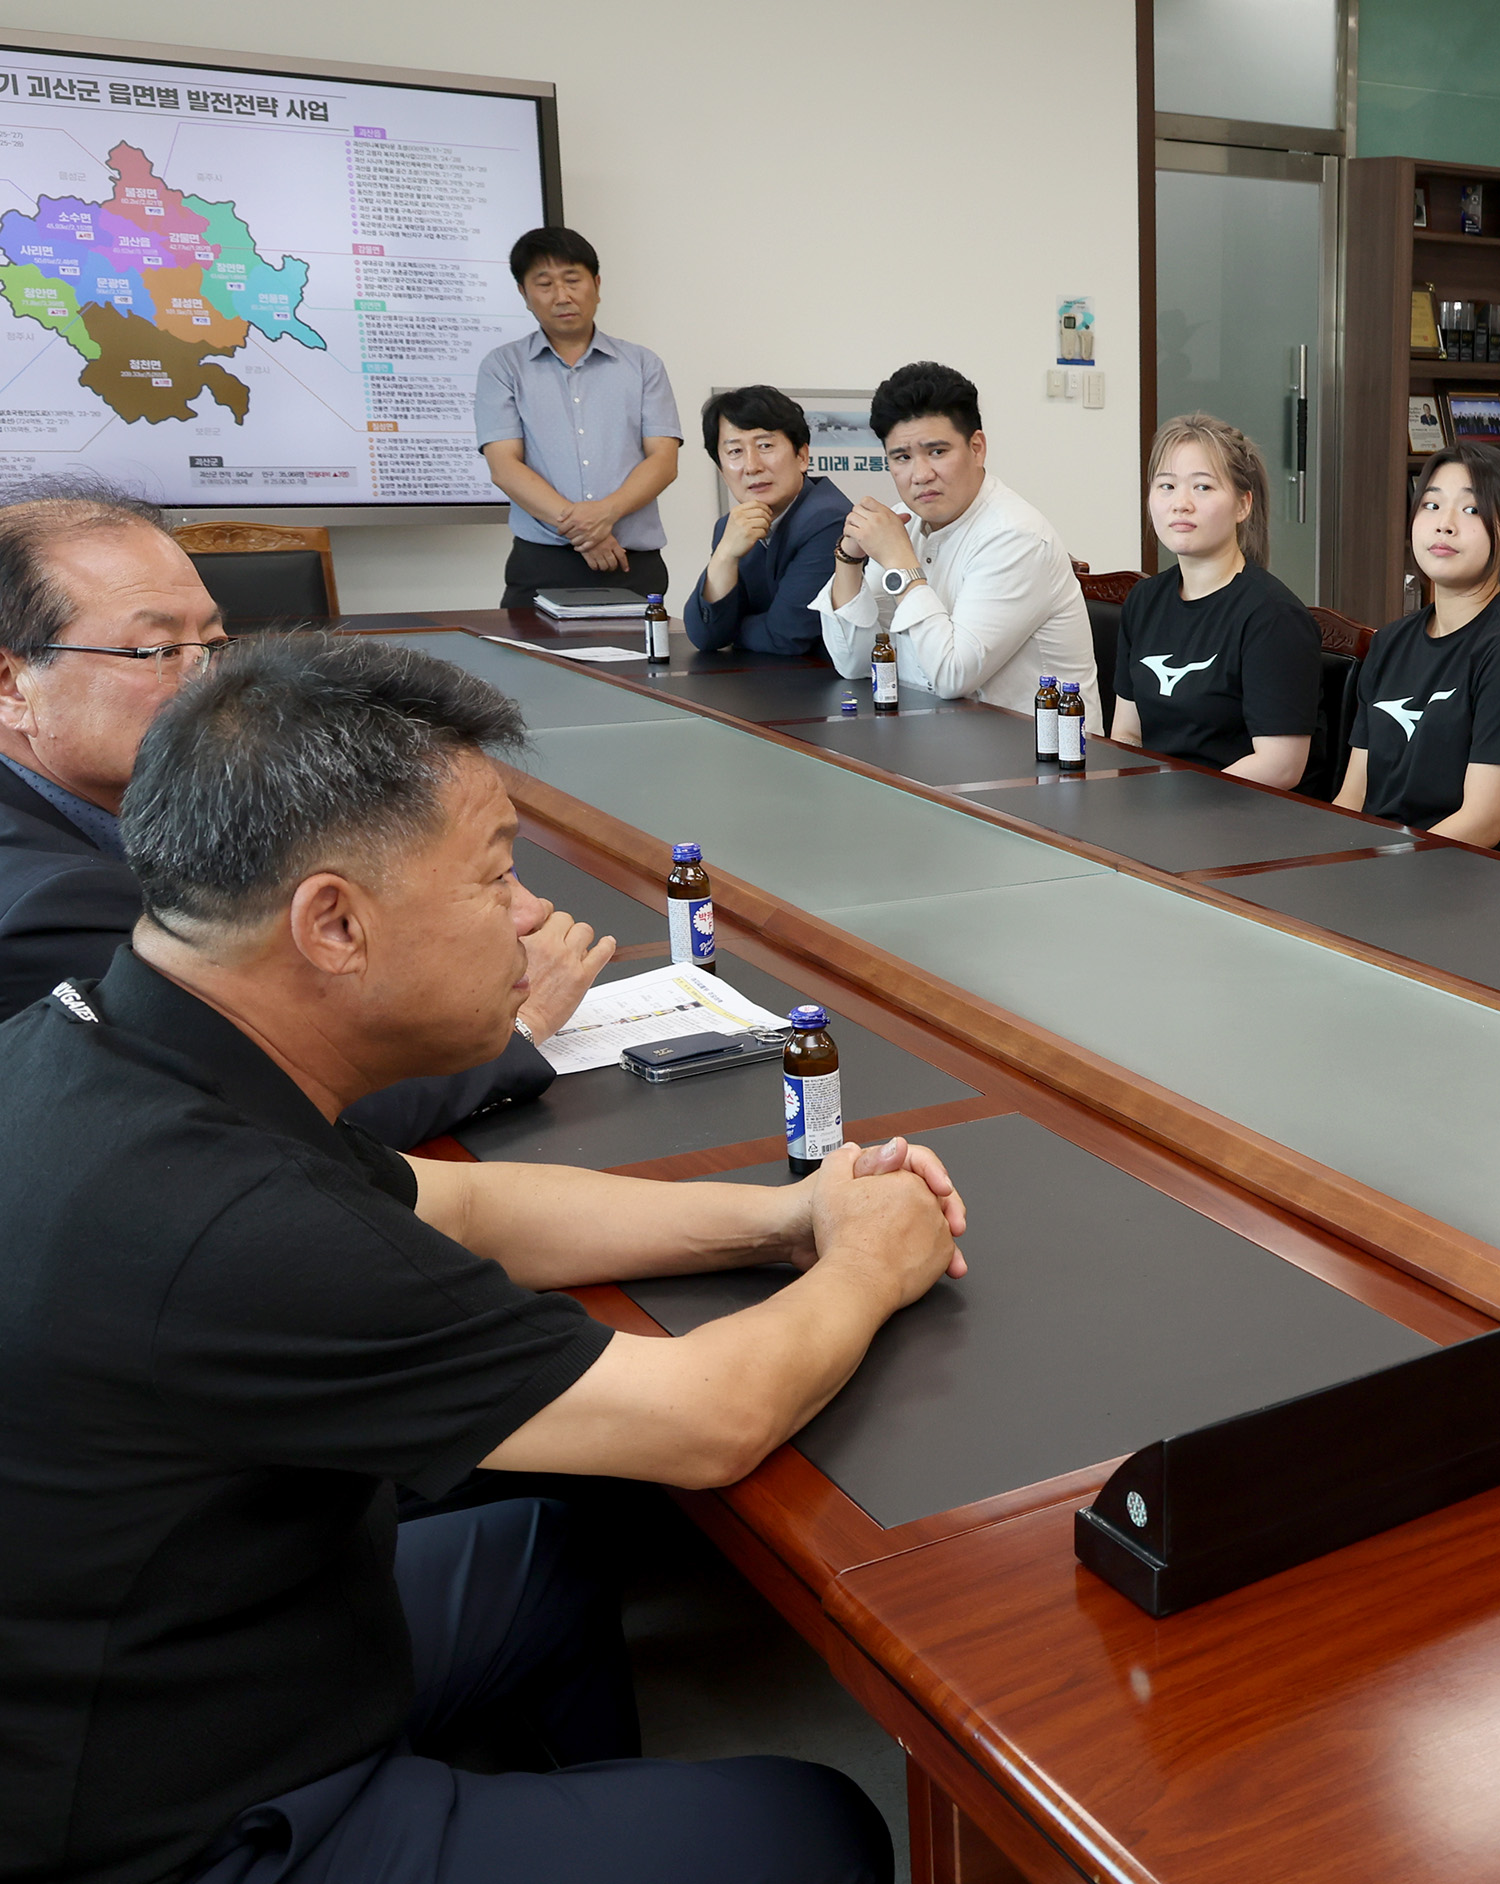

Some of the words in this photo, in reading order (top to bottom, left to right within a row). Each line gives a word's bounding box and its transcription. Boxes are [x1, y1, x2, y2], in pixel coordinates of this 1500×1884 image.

[27, 75, 101, 102] 괴산군
[108, 82, 181, 110] 읍면별
[187, 89, 279, 118] 발전전략
[285, 98, 330, 122] 사업
[58, 212, 92, 224] 소수면
[119, 236, 151, 248] 괴산읍
[169, 233, 201, 245] 감물면
[20, 245, 54, 257] 사리면
[96, 278, 130, 289] 문광면
[24, 287, 58, 300] 청안면
[129, 359, 162, 371] 청천면
[818, 456, 849, 472] 미래
